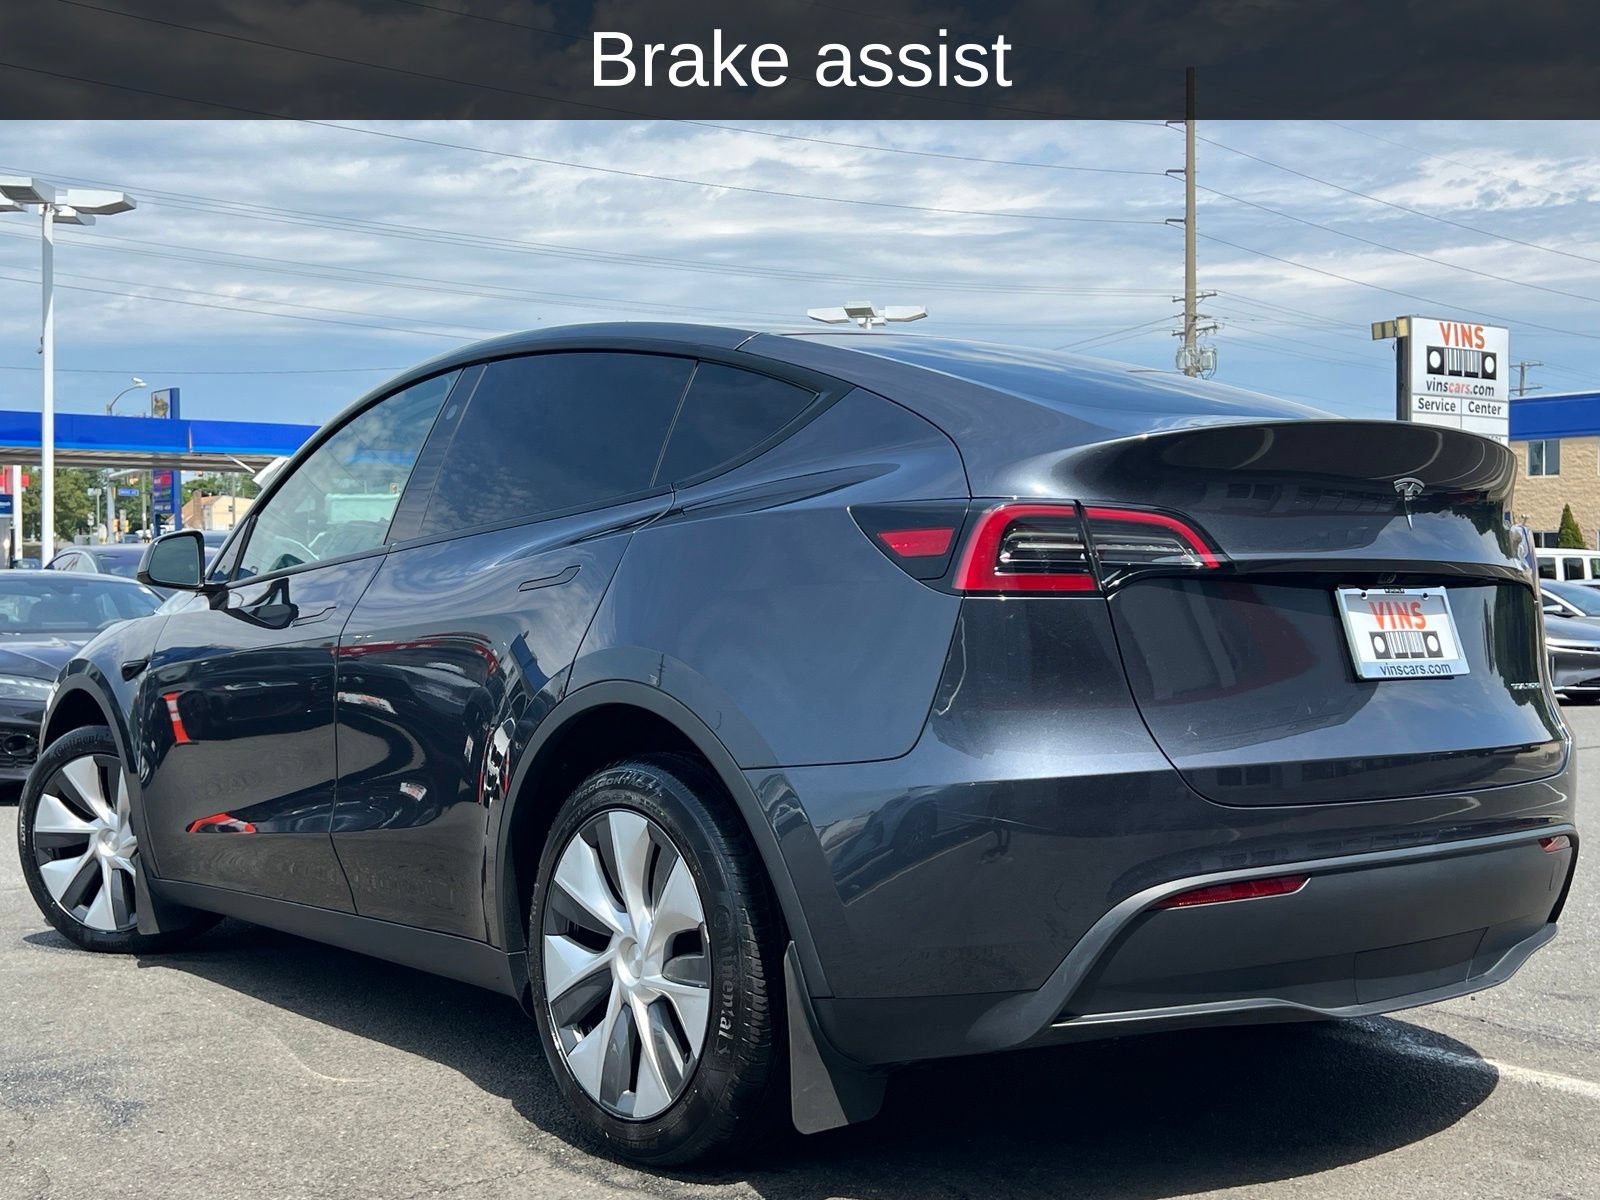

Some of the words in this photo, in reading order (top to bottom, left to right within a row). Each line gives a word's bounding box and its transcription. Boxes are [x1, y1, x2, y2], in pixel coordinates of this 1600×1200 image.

[1439, 322, 1486, 349] VINS
[1426, 378, 1495, 397] vinscars.com
[1418, 397, 1456, 412] Service
[1468, 401, 1502, 415] Center
[1369, 601, 1427, 630] VINS
[1380, 661, 1452, 676] vinscars.com
